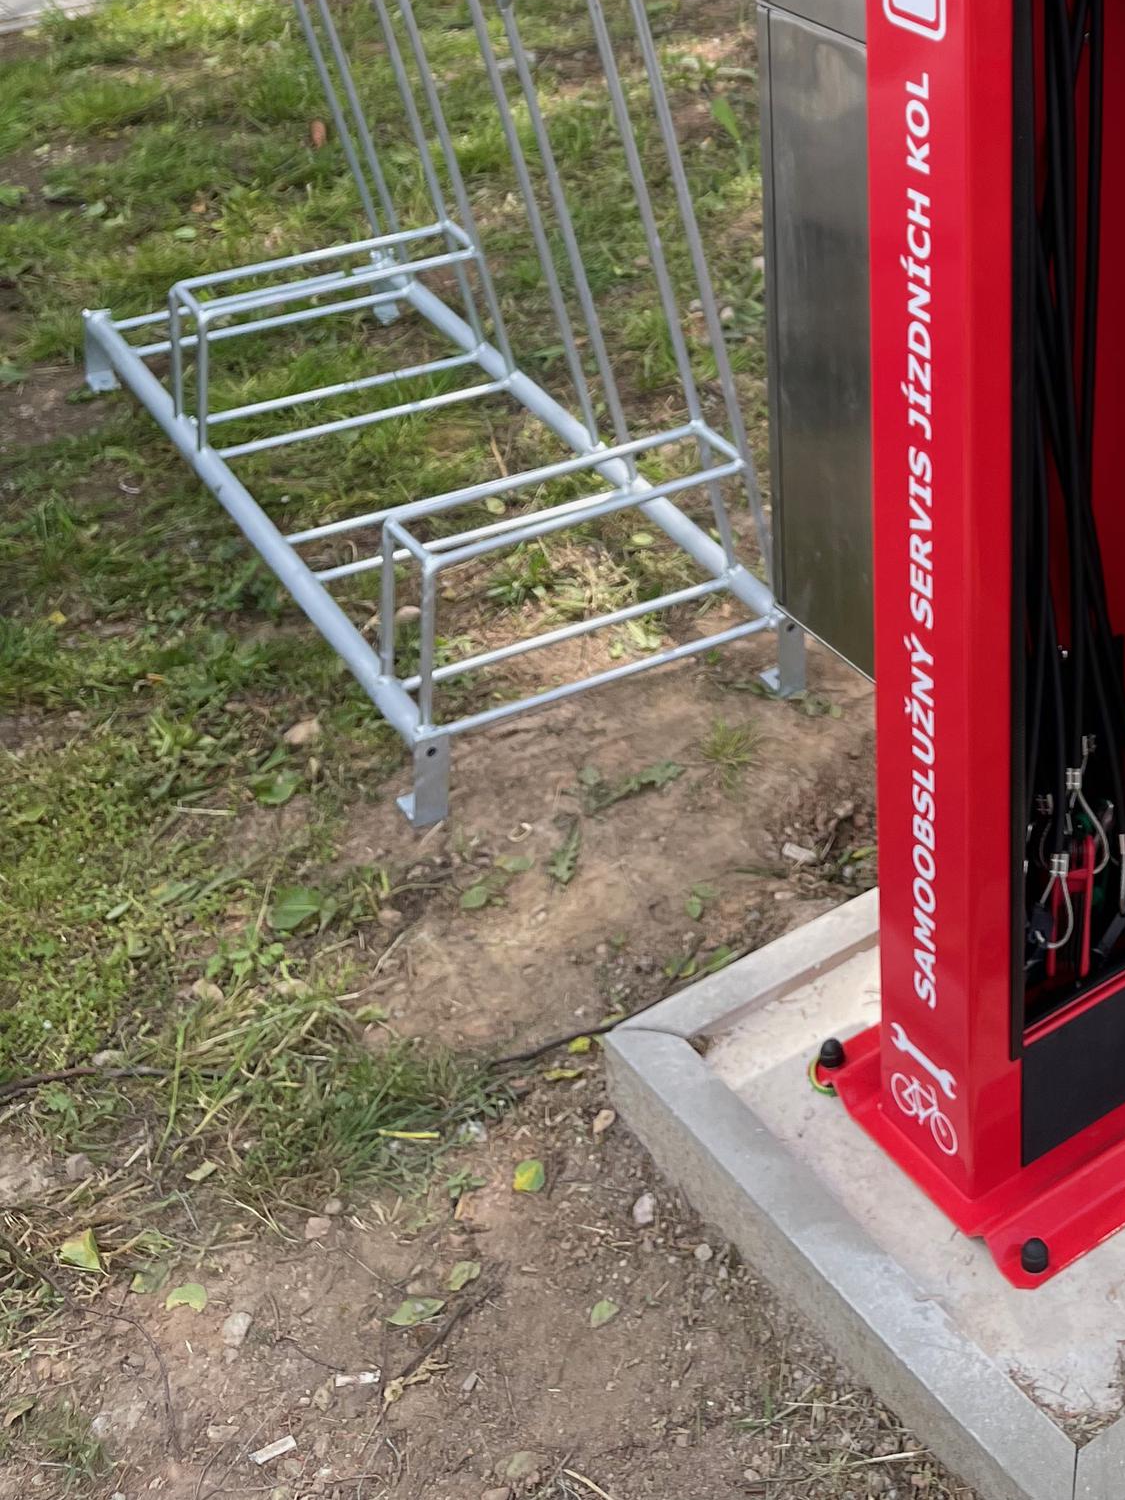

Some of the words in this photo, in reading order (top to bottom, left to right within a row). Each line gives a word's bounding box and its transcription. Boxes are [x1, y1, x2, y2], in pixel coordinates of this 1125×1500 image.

[904, 72, 931, 175] KOL
[900, 187, 933, 440] JÍZDNÍCH
[907, 445, 934, 631] SERVIS
[904, 632, 937, 1010] SAMOOBSLUŽNÝ
